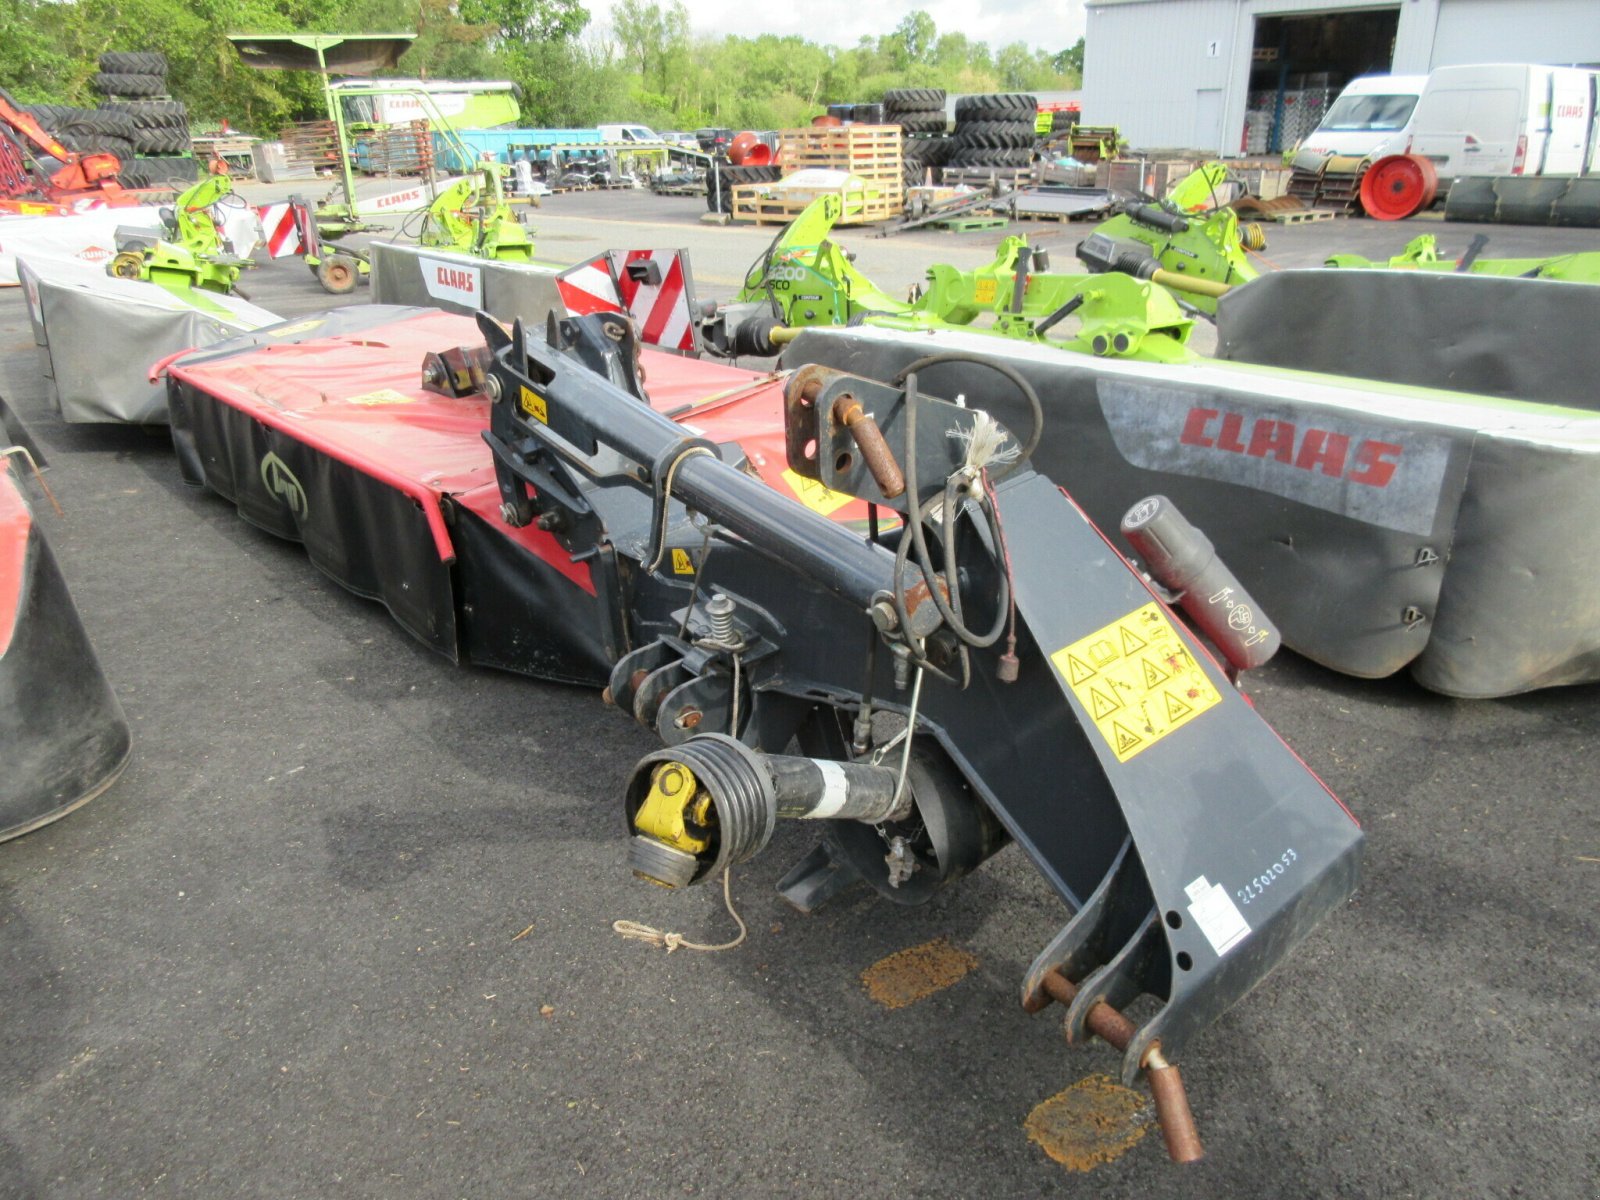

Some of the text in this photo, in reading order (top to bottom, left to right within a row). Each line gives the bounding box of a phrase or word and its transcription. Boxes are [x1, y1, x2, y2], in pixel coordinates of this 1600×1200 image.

[1209, 42, 1217, 56] 1
[1557, 104, 1584, 118] CLAAS
[377, 190, 420, 208] CLAAS
[437, 266, 474, 293] CLAAS
[1180, 407, 1404, 488] CLAAS
